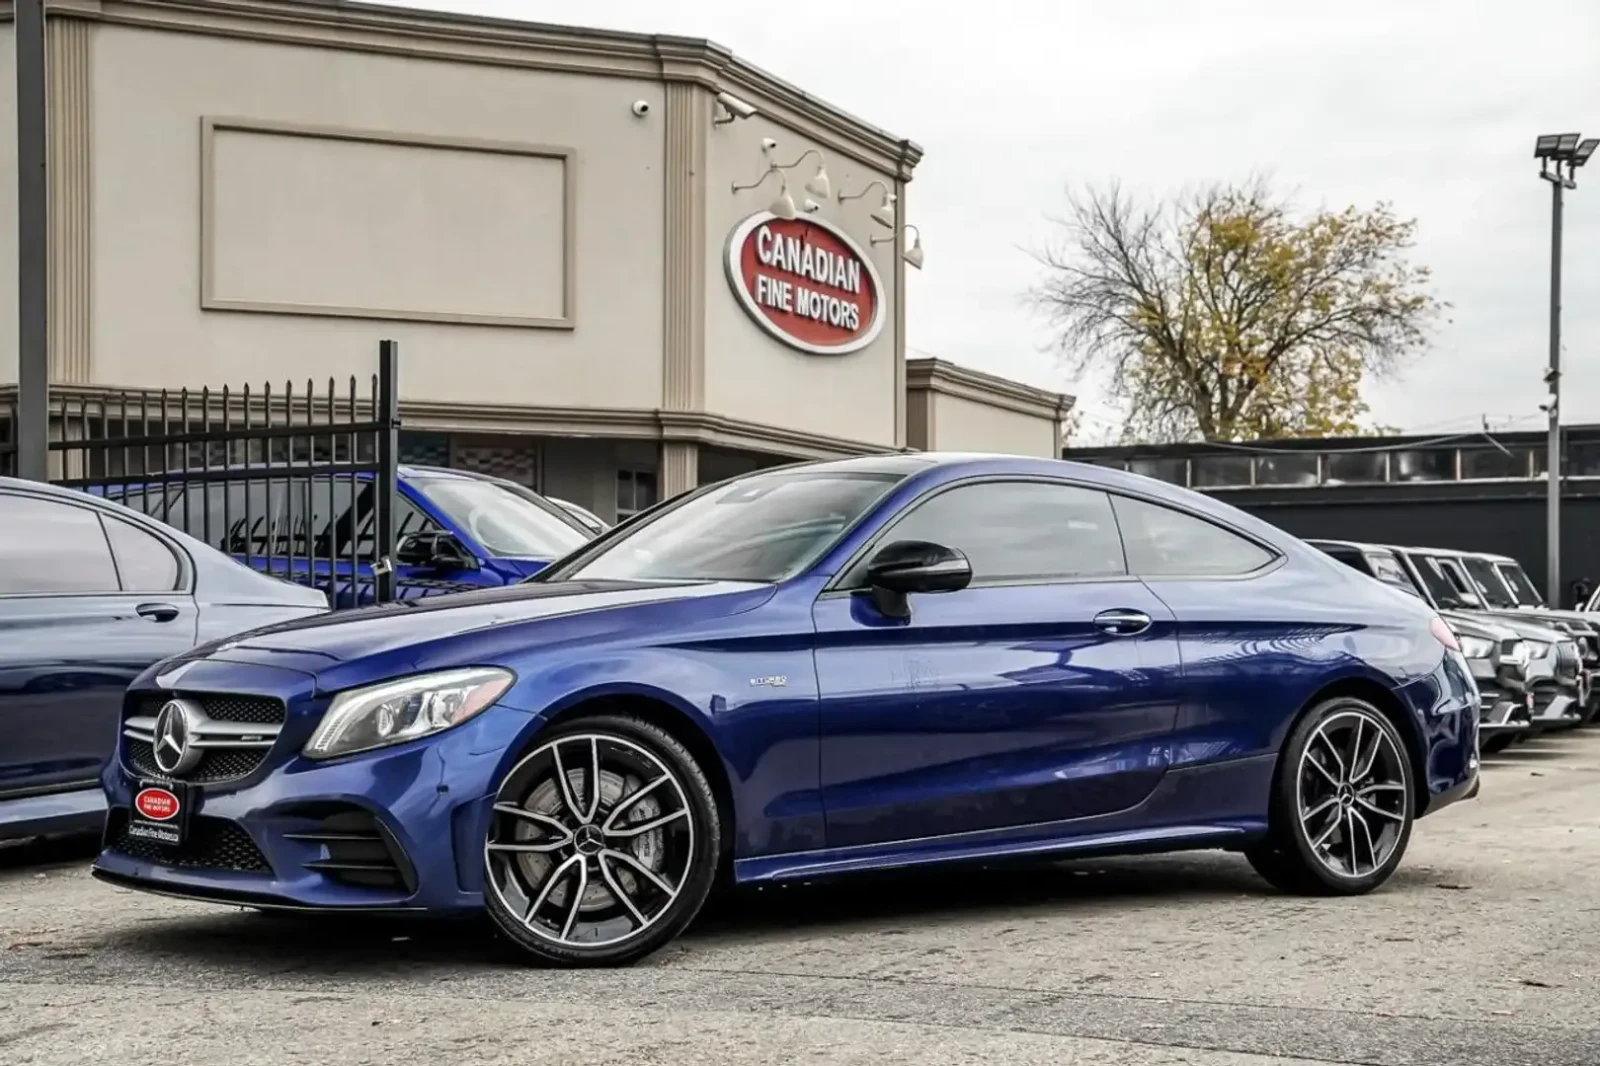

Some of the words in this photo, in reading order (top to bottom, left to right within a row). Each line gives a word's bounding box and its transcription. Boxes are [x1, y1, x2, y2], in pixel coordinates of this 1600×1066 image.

[757, 225, 860, 293] CANADIAN
[757, 274, 793, 312] FINE
[797, 286, 859, 331] MOTORS
